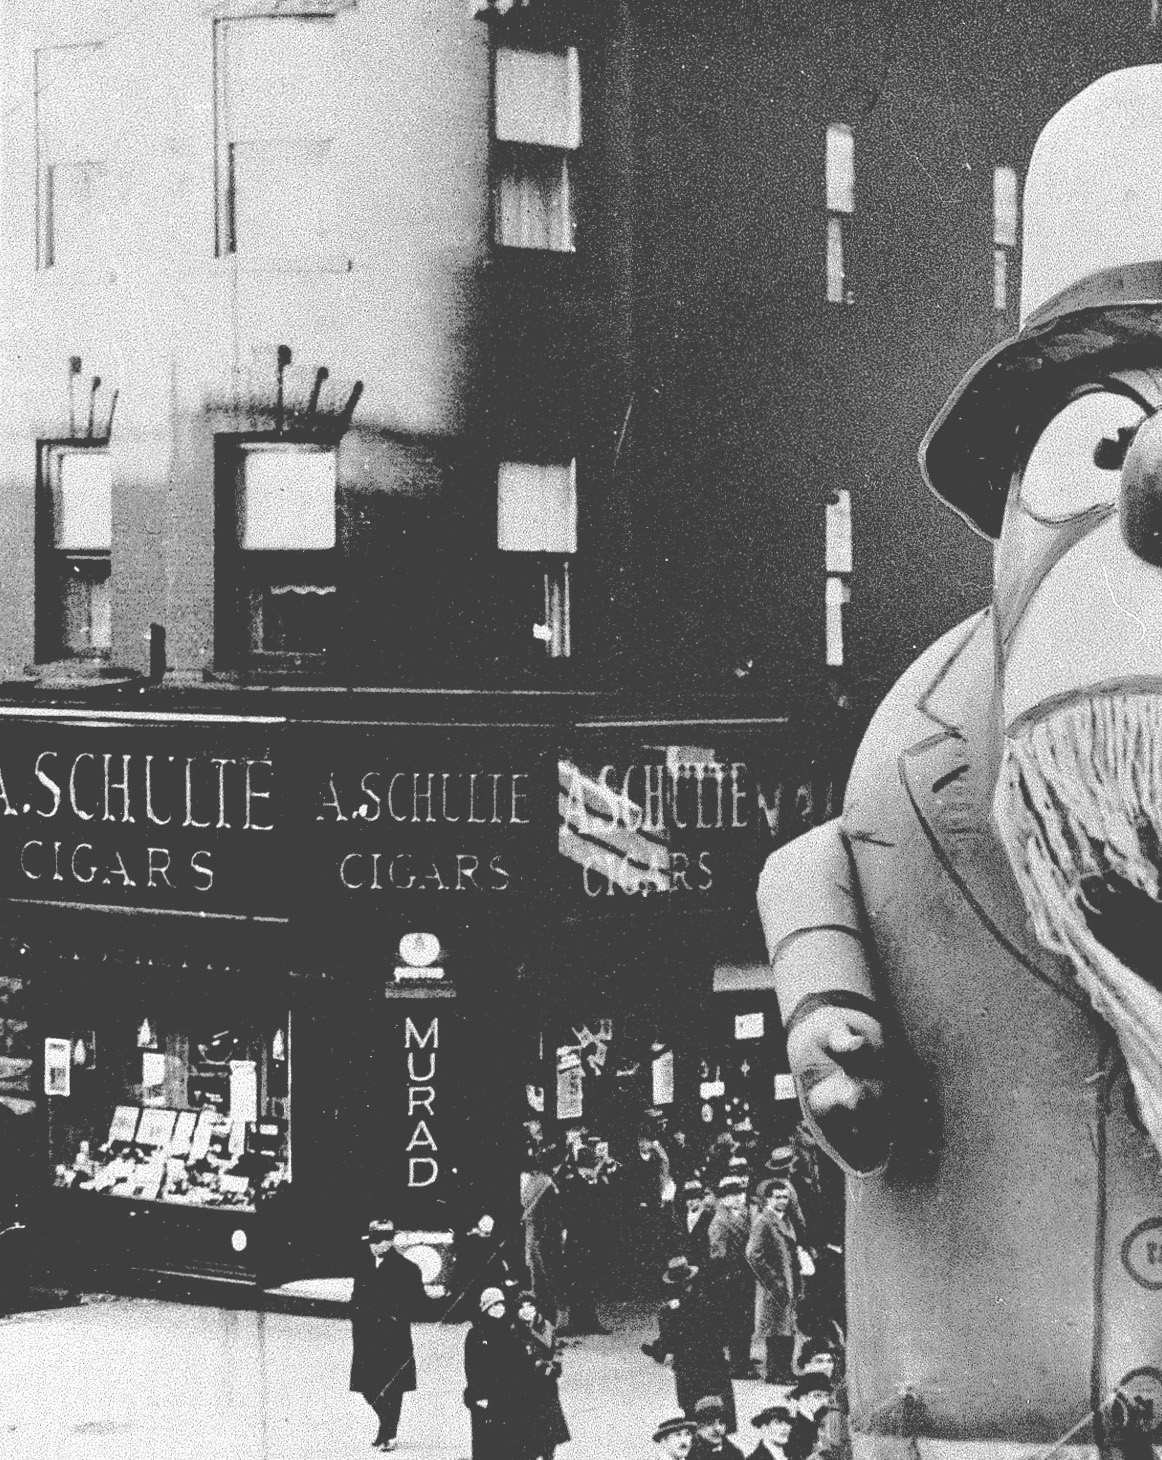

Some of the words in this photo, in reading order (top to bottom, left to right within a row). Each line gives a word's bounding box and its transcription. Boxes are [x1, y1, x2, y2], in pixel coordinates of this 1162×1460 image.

[21, 840, 214, 891] CIGARS
[340, 853, 510, 890] CIGARS
[404, 1016, 439, 1188] MURAD
